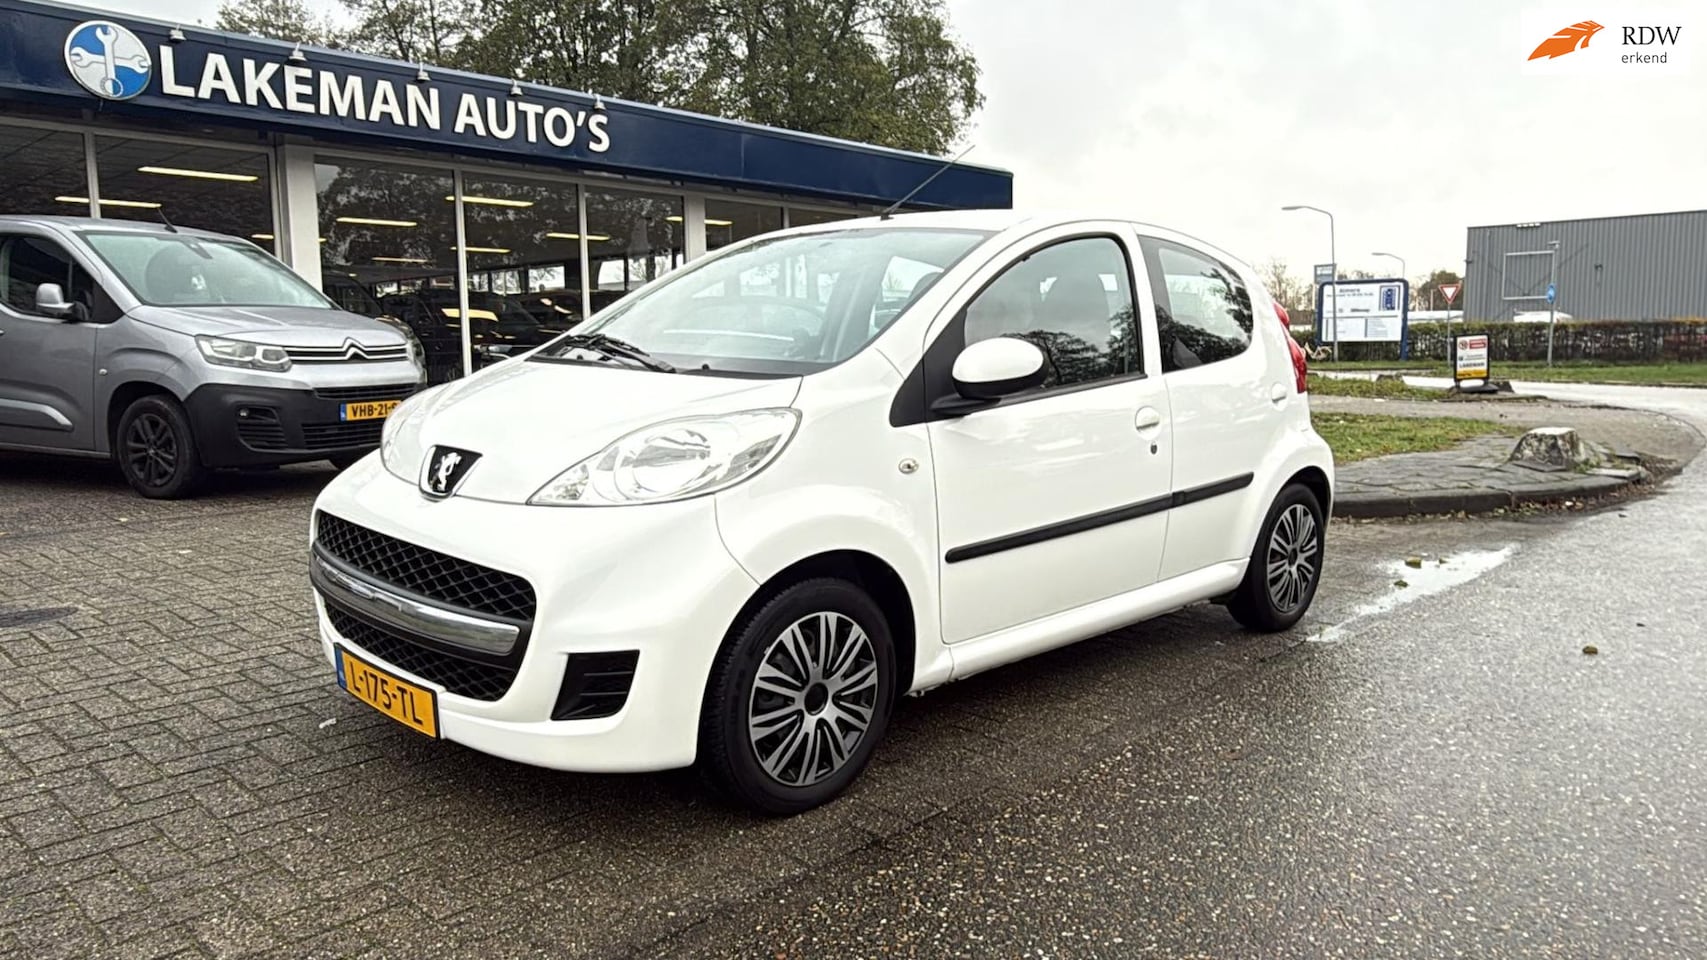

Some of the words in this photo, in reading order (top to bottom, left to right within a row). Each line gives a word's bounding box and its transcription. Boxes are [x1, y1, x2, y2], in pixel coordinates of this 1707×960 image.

[159, 45, 441, 130] LAKEMAN
[454, 93, 610, 152] AUTO'S
[350, 660, 424, 726] L-175-TL
